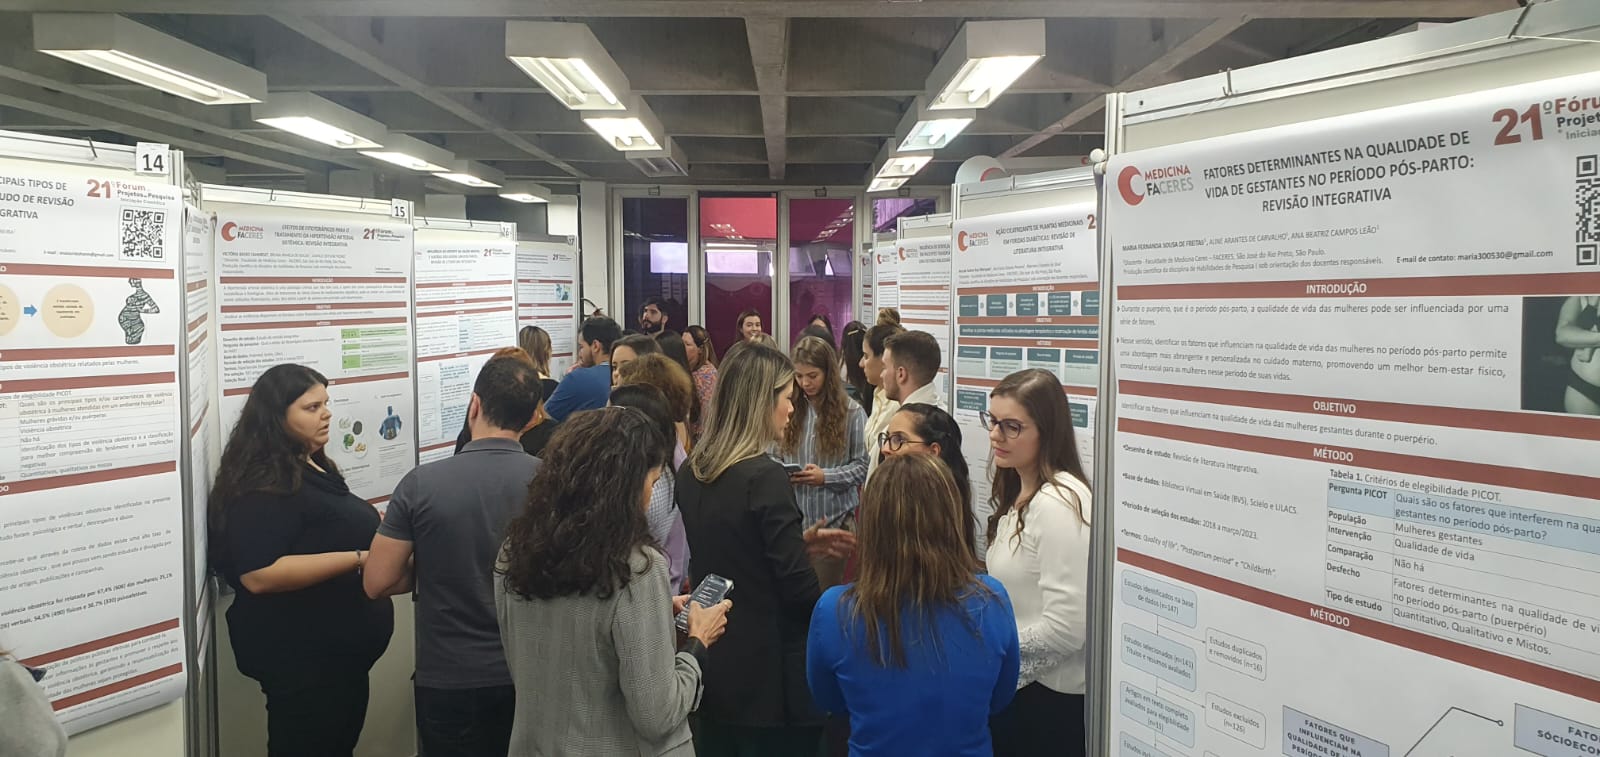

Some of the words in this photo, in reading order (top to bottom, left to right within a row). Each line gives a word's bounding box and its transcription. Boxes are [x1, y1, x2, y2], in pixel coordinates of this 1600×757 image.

[142, 154, 164, 172] 14
[1203, 164, 1245, 180] FATORES
[1247, 149, 1341, 174] DETERMINANTES
[1344, 147, 1364, 161] NA
[1366, 134, 1446, 158] QUALIDADE
[1450, 130, 1470, 146] DE
[1145, 164, 1191, 181] MEDICINA
[1205, 184, 1228, 198] VIDA
[1232, 184, 1244, 196] DE
[1246, 176, 1305, 194] GESTANTES
[1308, 173, 1326, 186] NO
[1330, 166, 1386, 184] PERÍODO
[1390, 154, 1474, 177] PÓS-PARTO:
[28, 179, 54, 189] TIPOS
[56, 182, 67, 190] DE
[1147, 177, 1194, 196] FACERES
[22, 194, 35, 204] DE
[36, 196, 74, 206] REVISÃO
[1262, 194, 1308, 212] REVISÃO
[1312, 187, 1392, 206] INTEGRATIVA
[394, 206, 406, 218] 15
[1330, 228, 1358, 238] CAMPOS
[1396, 255, 1416, 264] E-mail
[1428, 254, 1456, 262] contato:
[1458, 250, 1554, 261] maria300530@gmail.com
[1306, 282, 1367, 296] INTRODUÇÃO
[1302, 304, 1316, 313] vida
[1319, 304, 1332, 313] das
[1334, 304, 1368, 313] mulheres
[1371, 304, 1392, 314] pode
[1410, 304, 1464, 313] influenciada
[1468, 305, 1483, 314] por
[1309, 344, 1323, 352] vida
[1325, 344, 1338, 352] das
[1340, 344, 1374, 354] mulheres
[1424, 346, 1466, 358] pós-parto
[1470, 348, 1508, 360] permite
[1326, 360, 1374, 371] promovendo
[1394, 362, 1424, 373] melhor
[1428, 364, 1473, 375] bem-estar
[1313, 400, 1356, 414] OBJETIVO
[1286, 420, 1317, 431] mulheres
[1319, 424, 1352, 436] gestantes
[1355, 428, 1384, 440] durante
[1394, 432, 1438, 445] puerpério.
[1314, 448, 1354, 462] MÉTODO
[1329, 482, 1362, 496] Pergunta
[1364, 488, 1388, 500] PICOT
[1330, 469, 1354, 480] Tabela
[1364, 474, 1398, 487] Critérios
[1400, 480, 1410, 488] de
[1412, 480, 1468, 496] elegibilidade
[1328, 510, 1366, 525] População
[1396, 493, 1420, 504] Quais
[1422, 498, 1437, 508] são
[1440, 502, 1450, 510] os
[1452, 501, 1486, 515] fatores
[1488, 508, 1506, 518] que
[1509, 510, 1563, 528] interferem
[1566, 521, 1579, 530] na
[1395, 508, 1436, 522] gestantes
[1438, 516, 1450, 524] no
[1493, 524, 1548, 540] pós-parto?
[1328, 526, 1372, 541] Intervenção
[1395, 523, 1436, 538] Mulheres
[1438, 532, 1482, 546] gestantes
[1328, 544, 1374, 560] Comparação
[1394, 538, 1440, 554] Qualidade
[1442, 546, 1453, 556] de
[1455, 550, 1474, 561] vida
[1326, 562, 1360, 578] Desfecho
[1394, 558, 1411, 569] Não
[1414, 562, 1424, 572] há
[1326, 590, 1342, 600] Tipo
[1344, 595, 1354, 604] de
[1356, 599, 1382, 612] estudo
[1394, 578, 1424, 592] Fatores
[1428, 586, 1497, 609] determinantes
[1502, 603, 1514, 612] na
[1518, 606, 1568, 626] qualidade
[1572, 619, 1586, 630] de
[1310, 608, 1350, 627] MÉTODO
[1394, 593, 1404, 602] no
[1406, 595, 1440, 610] período
[1442, 604, 1488, 622] pós-parto
[1490, 614, 1548, 638] (puerpério)
[1394, 608, 1450, 630] Quantitativo,
[1452, 622, 1504, 643] Qualitativo
[1507, 636, 1514, 644] e
[1516, 637, 1552, 656] Mistos.
[1232, 644, 1262, 661] duplicados
[1300, 728, 1348, 752] INFLUENCIAM
[1305, 720, 1337, 738] FATORES
[1340, 733, 1355, 744] QUE
[1568, 726, 1600, 743] FATO
[1288, 732, 1328, 754] QUALIDADE
